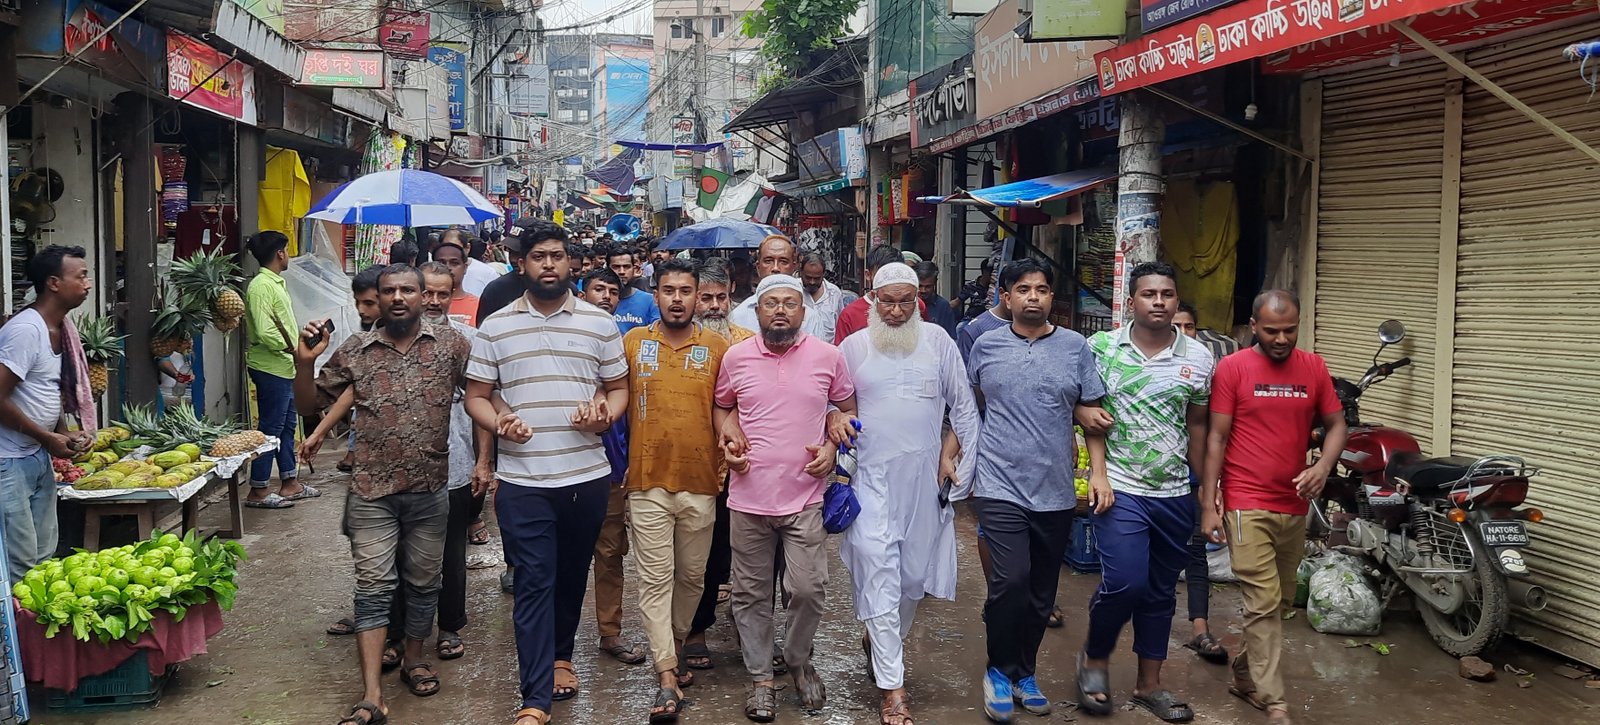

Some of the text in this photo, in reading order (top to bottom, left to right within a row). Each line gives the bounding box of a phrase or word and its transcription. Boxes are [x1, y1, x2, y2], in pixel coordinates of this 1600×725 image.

[1115, 0, 1333, 81] ঢাকা কাচ্চি ডাইন ঢাকা কাচ্চি ডাইন
[331, 53, 354, 75] দই
[358, 58, 378, 76] ঘর
[980, 30, 1032, 92] ইসলাম
[643, 344, 656, 356] 62
[1486, 534, 1527, 543] HA-11-6618
[1487, 526, 1520, 534] NATORE
